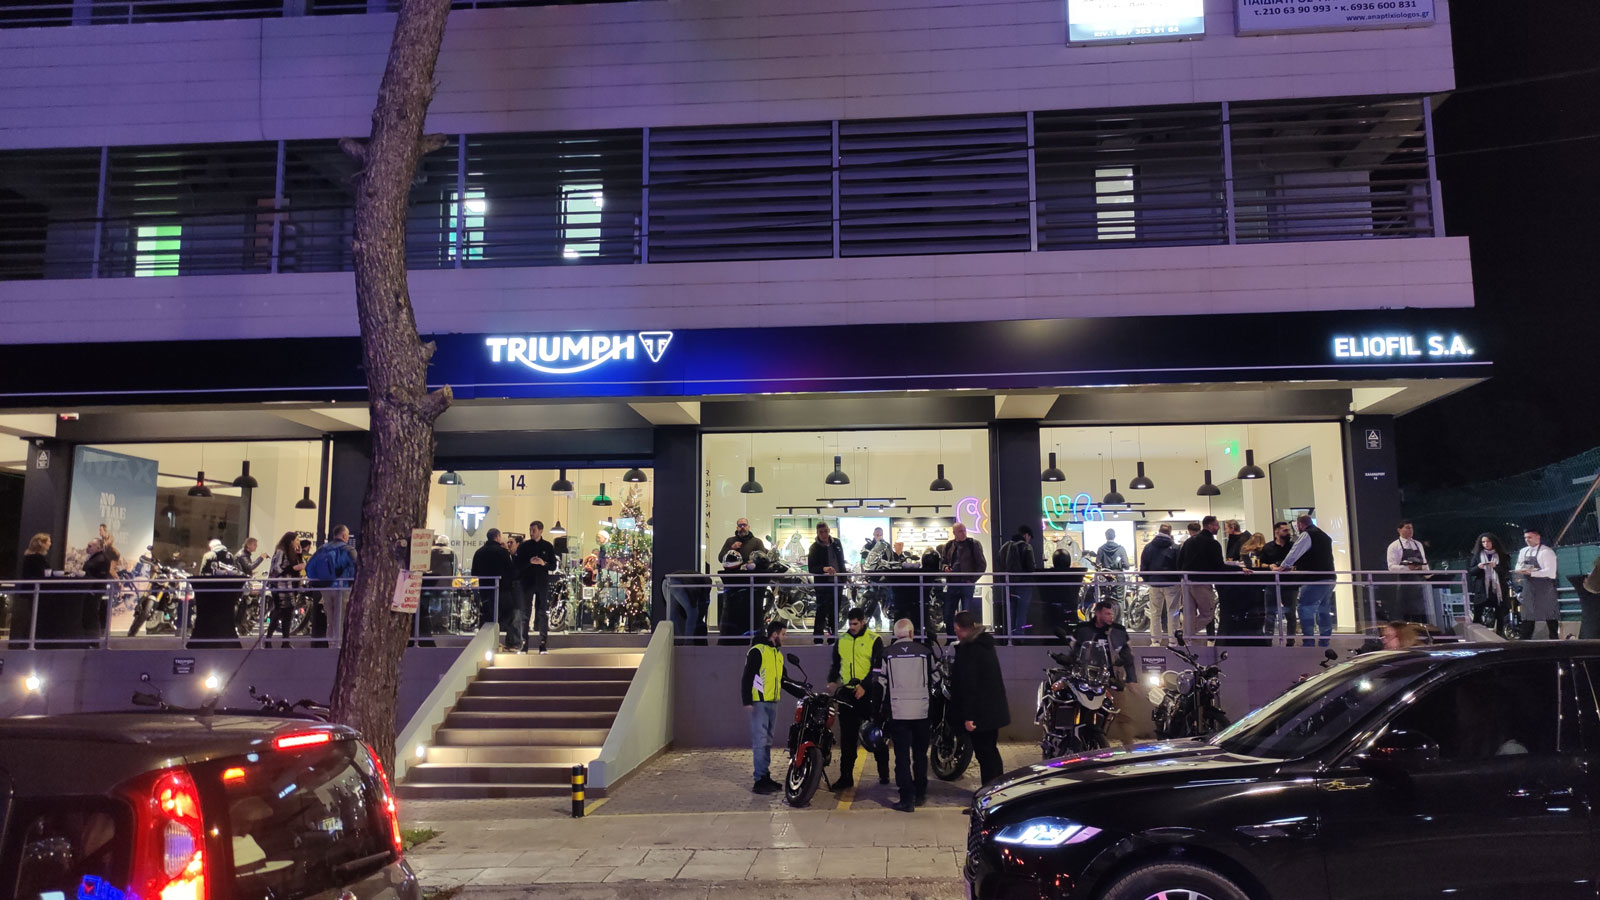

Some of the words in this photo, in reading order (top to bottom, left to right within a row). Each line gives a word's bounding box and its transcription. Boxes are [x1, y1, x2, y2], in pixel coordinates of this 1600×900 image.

[1377, 2, 1396, 10] 600
[1346, 11, 1429, 21] www.anaptixiologos.gr
[1335, 336, 1421, 357] ELIOFIL
[1428, 335, 1474, 356] S.A.
[486, 335, 635, 373] TRIUMPH
[510, 474, 526, 490] 14
[101, 492, 116, 506] NO
